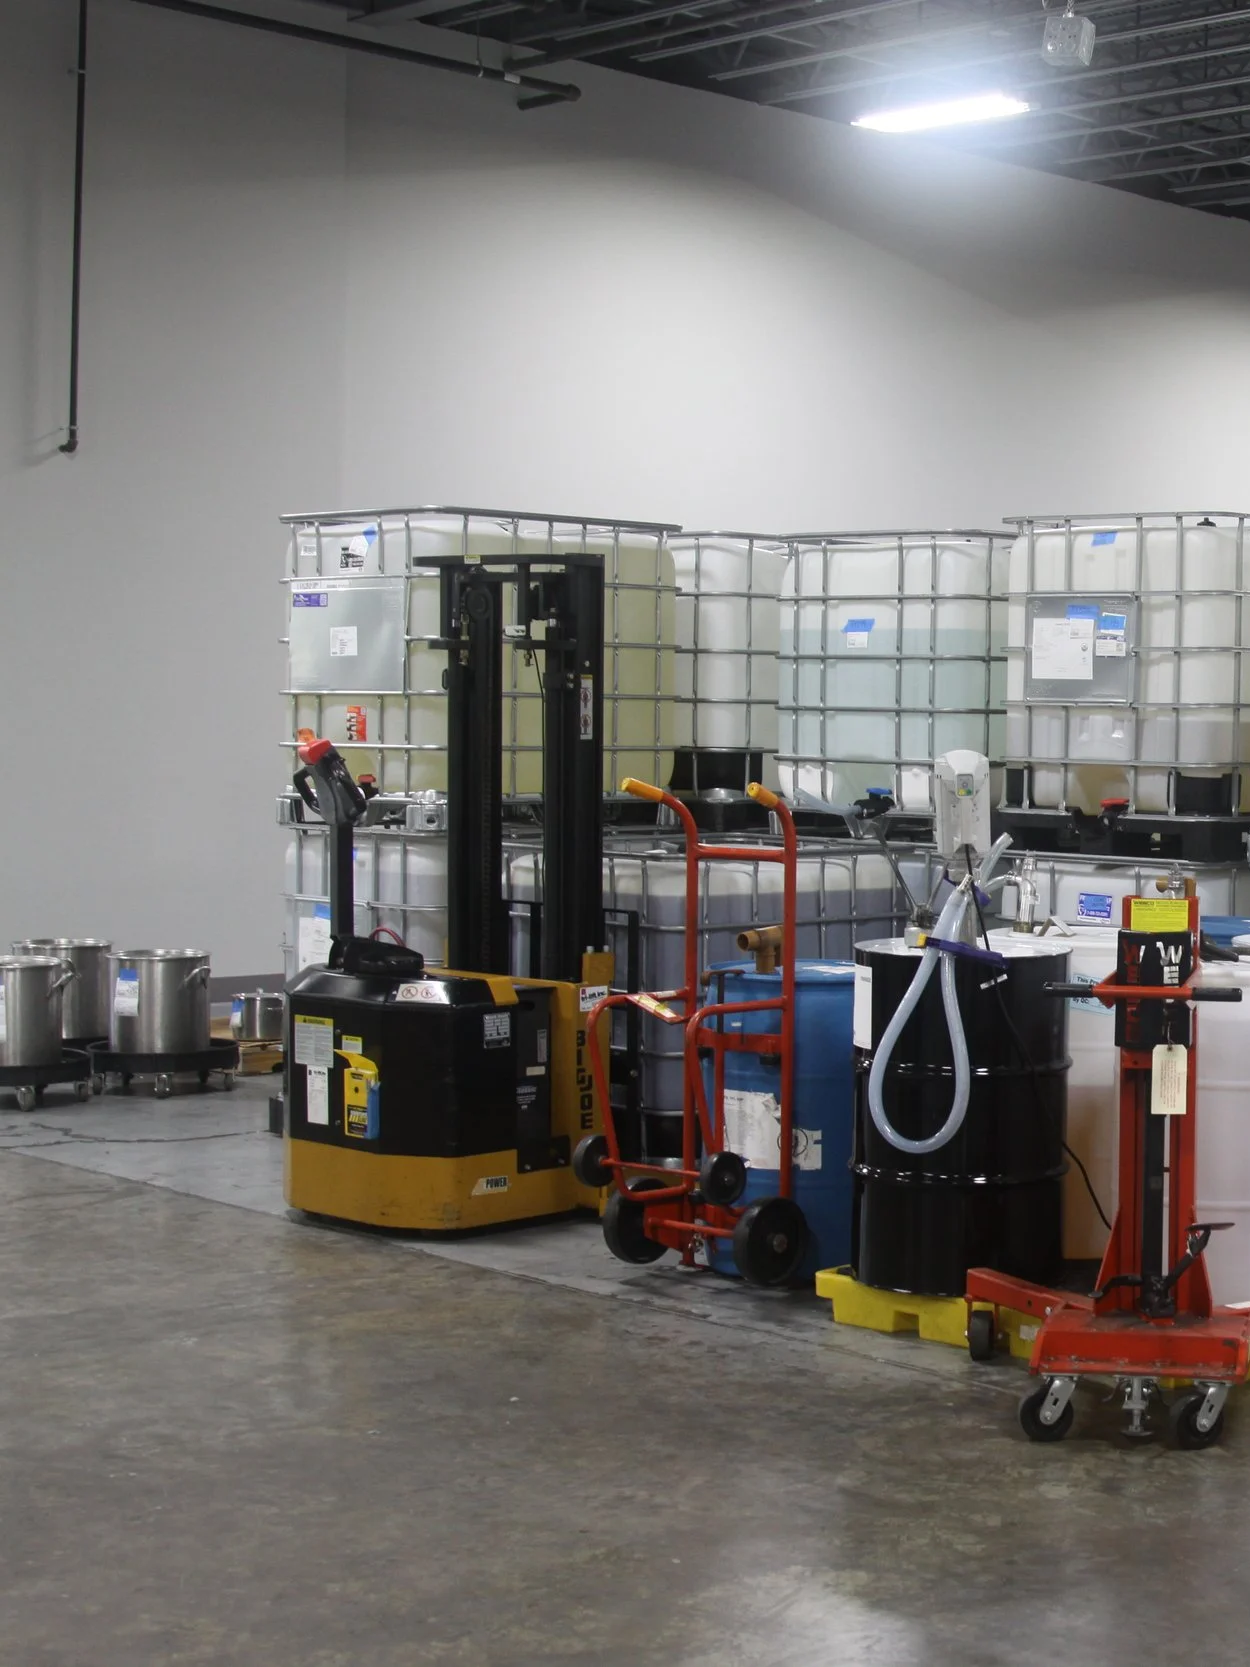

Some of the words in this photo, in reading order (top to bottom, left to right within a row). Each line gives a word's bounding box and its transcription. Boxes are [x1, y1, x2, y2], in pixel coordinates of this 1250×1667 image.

[576, 1030, 586, 1086] BIG
[580, 1074, 594, 1130] JOE
[486, 1177, 507, 1188] POWER
